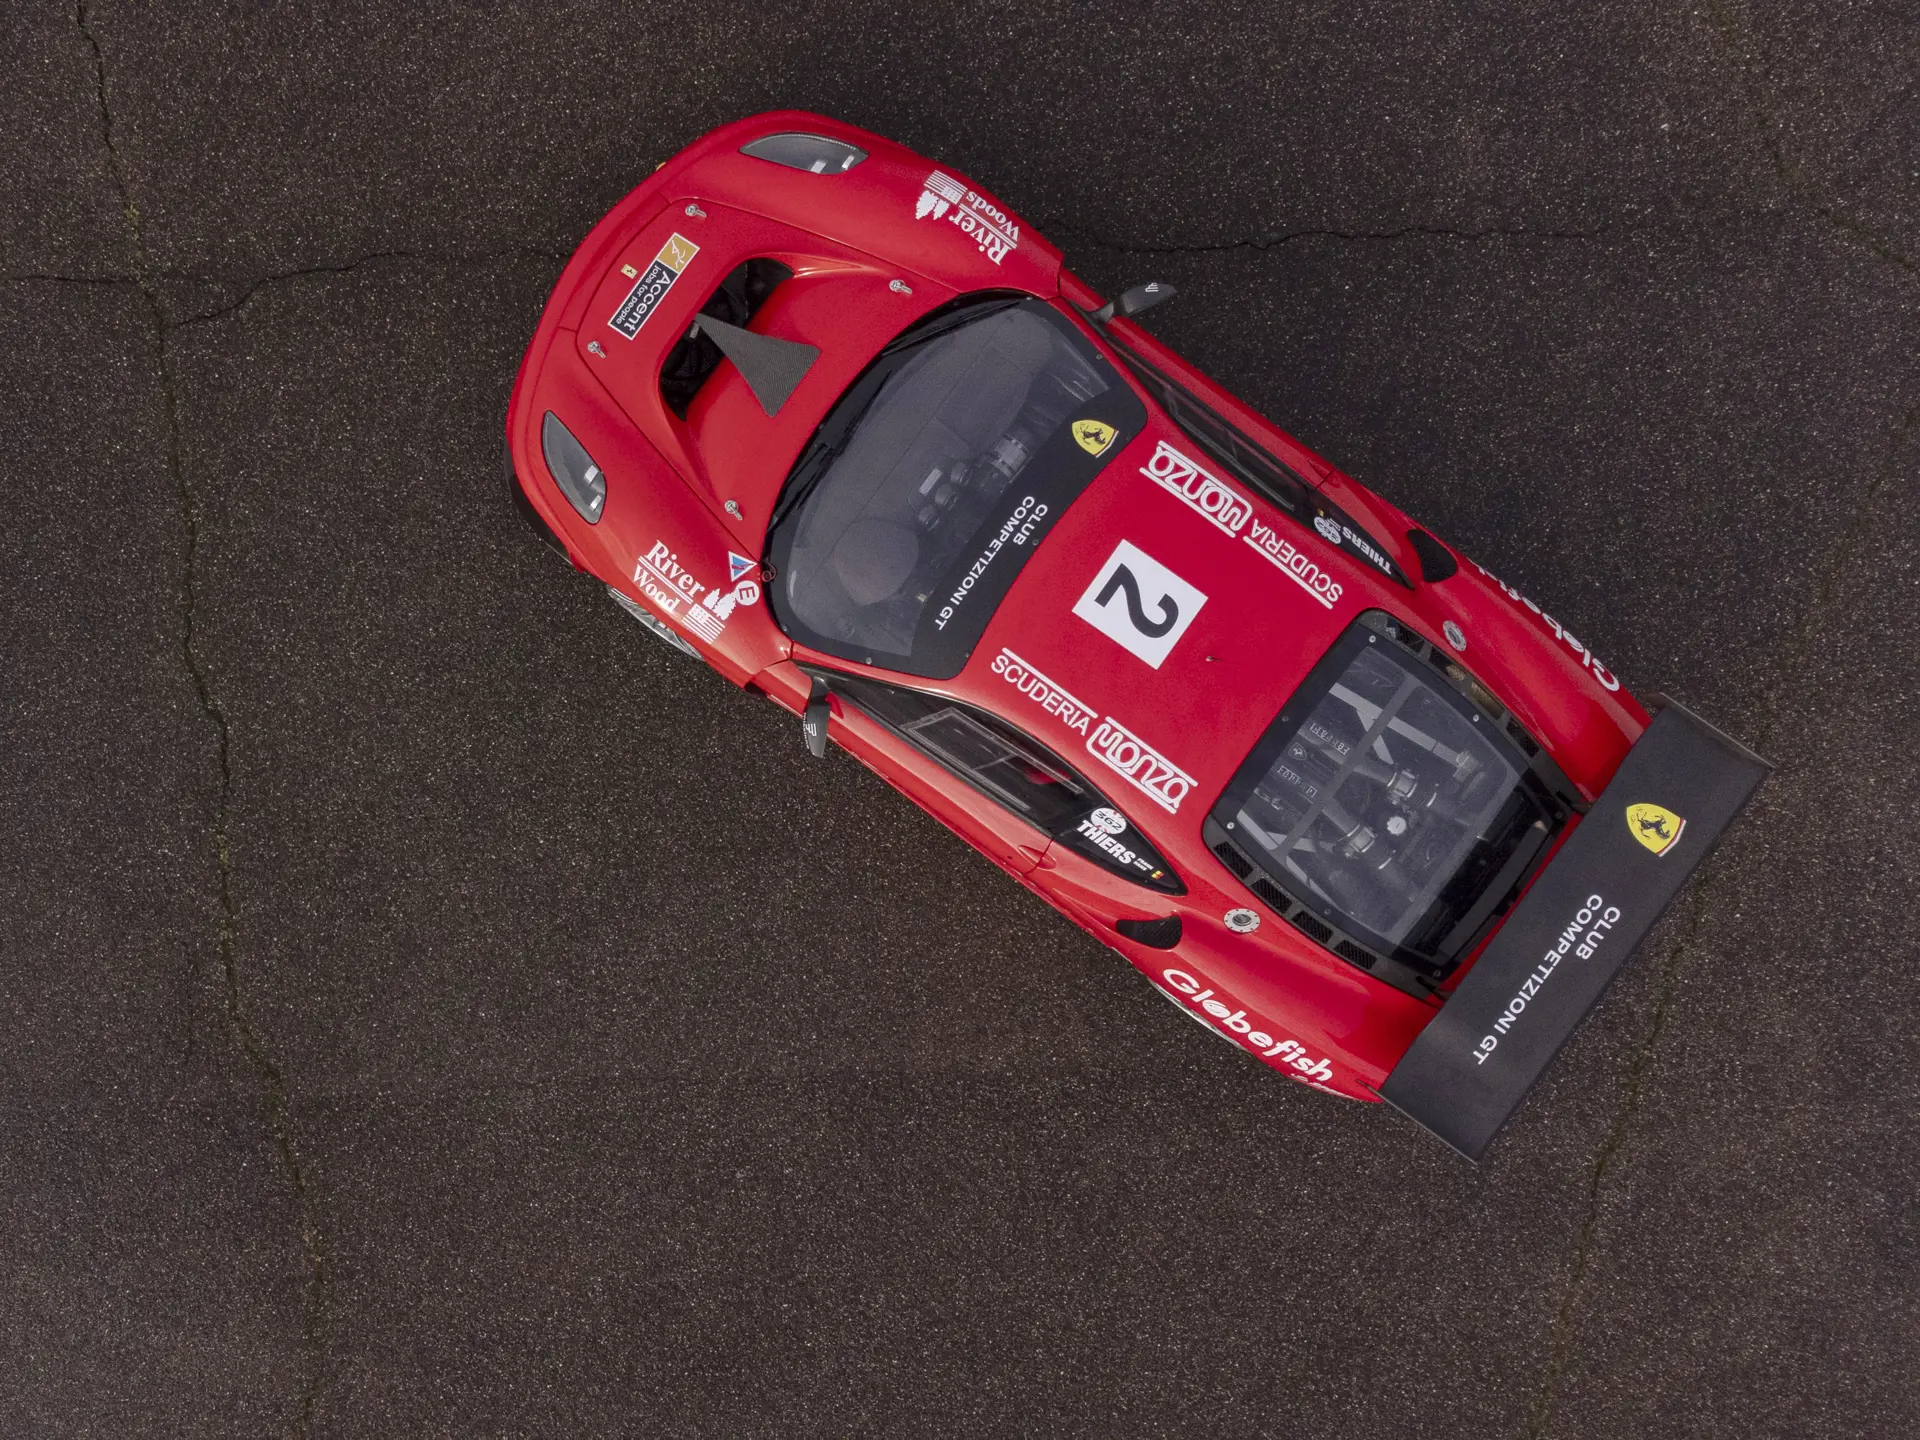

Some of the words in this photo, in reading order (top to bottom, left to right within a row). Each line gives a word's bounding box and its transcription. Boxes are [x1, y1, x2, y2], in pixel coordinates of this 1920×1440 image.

[949, 210, 1011, 265] River
[966, 192, 1020, 242] Woods
[636, 284, 649, 298] for
[645, 264, 662, 284] jobs
[615, 295, 639, 325] people
[624, 271, 670, 334] Accent
[1013, 503, 1049, 545] CLUB
[645, 540, 705, 599] River
[950, 495, 1036, 605] COMPETIZIONI
[1251, 519, 1343, 601] SCUDERIA
[1342, 527, 1392, 574] THIERS
[739, 586, 756, 600] E
[934, 605, 954, 631] GT
[1095, 564, 1178, 637] 2
[991, 654, 1091, 737] SCUDERIA
[1077, 820, 1136, 864] THIERS
[1097, 810, 1121, 831] 362
[1576, 907, 1621, 960] CLUB
[1494, 895, 1603, 1035] COMPETIZIONI
[1163, 969, 1333, 1086] Globefish
[1473, 1035, 1498, 1066] GT
